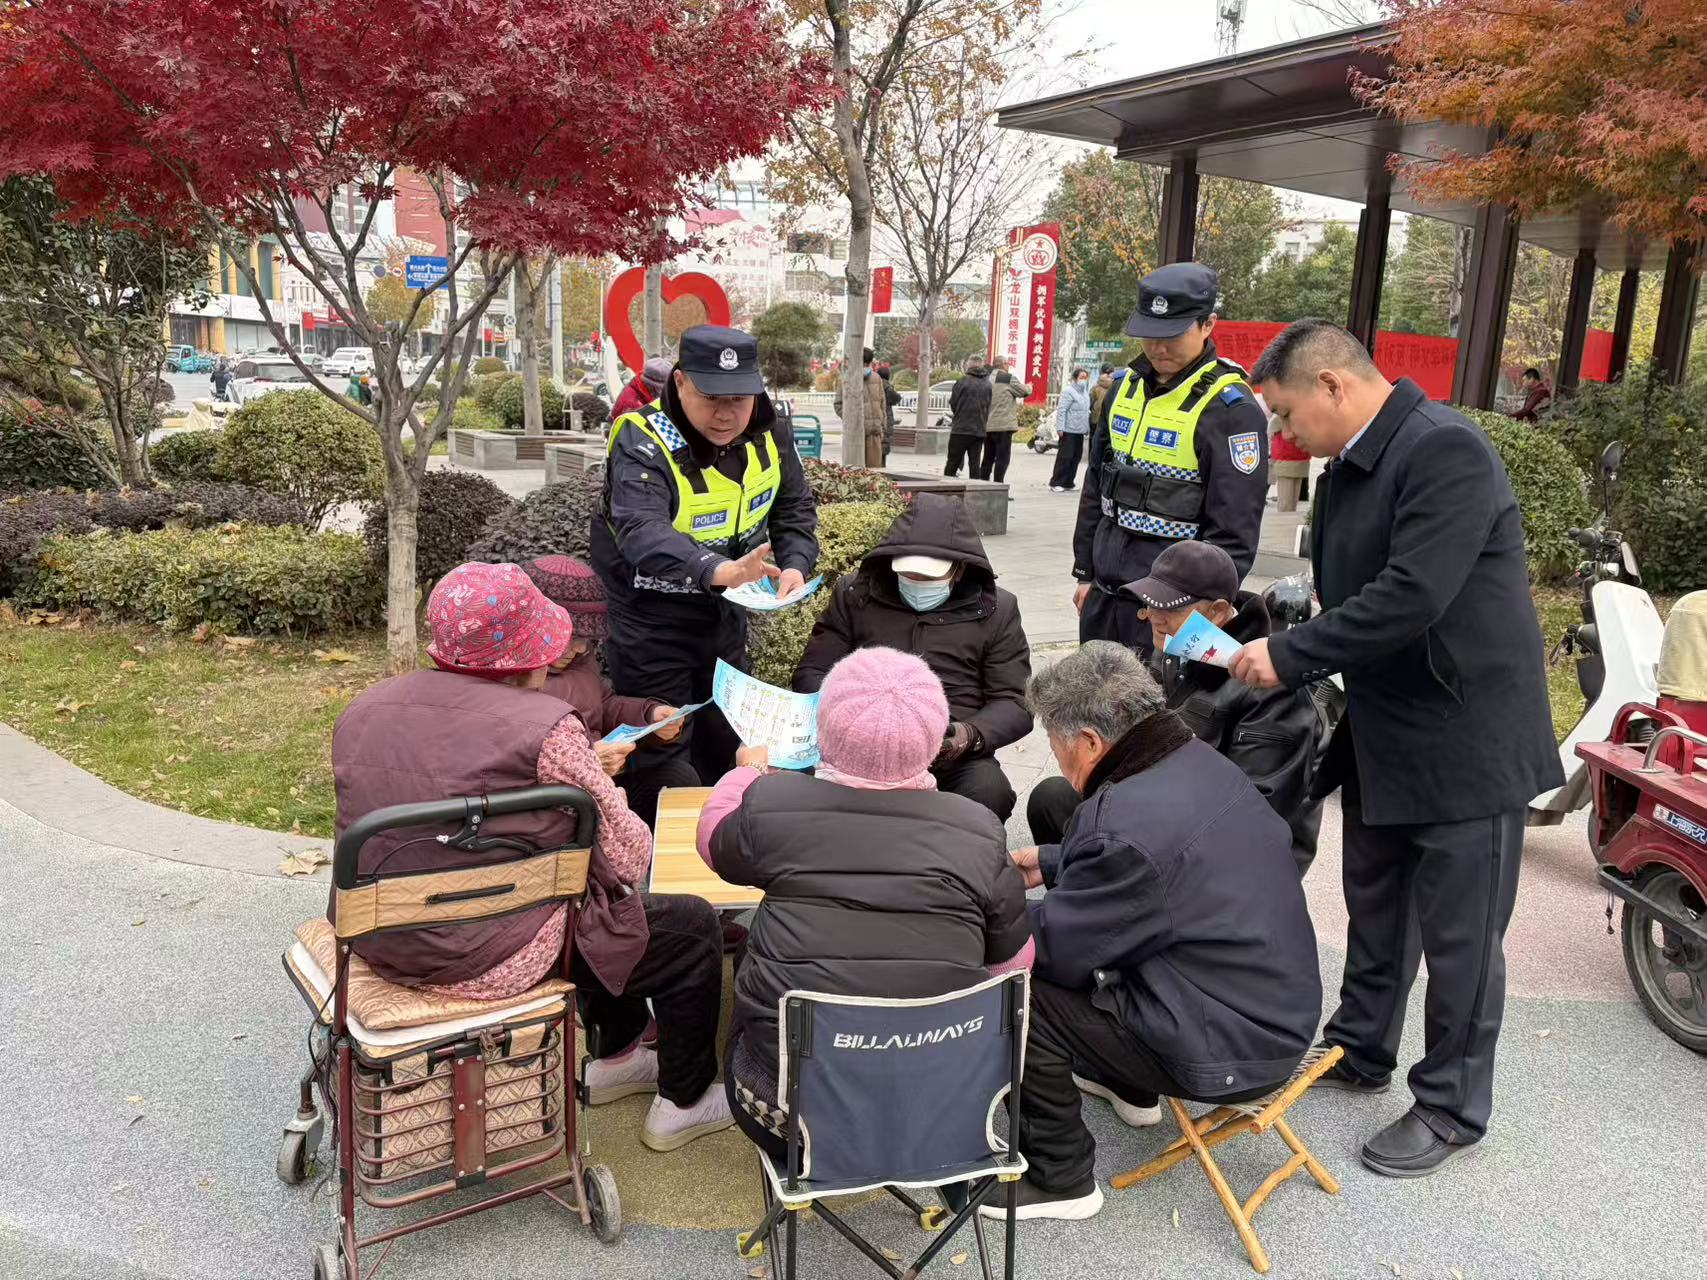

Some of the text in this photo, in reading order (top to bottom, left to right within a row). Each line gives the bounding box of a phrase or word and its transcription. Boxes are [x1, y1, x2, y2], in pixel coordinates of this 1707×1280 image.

[1148, 429, 1173, 445] 警察
[695, 512, 725, 525] POLICE
[833, 1015, 984, 1050] BILLALWAYS
